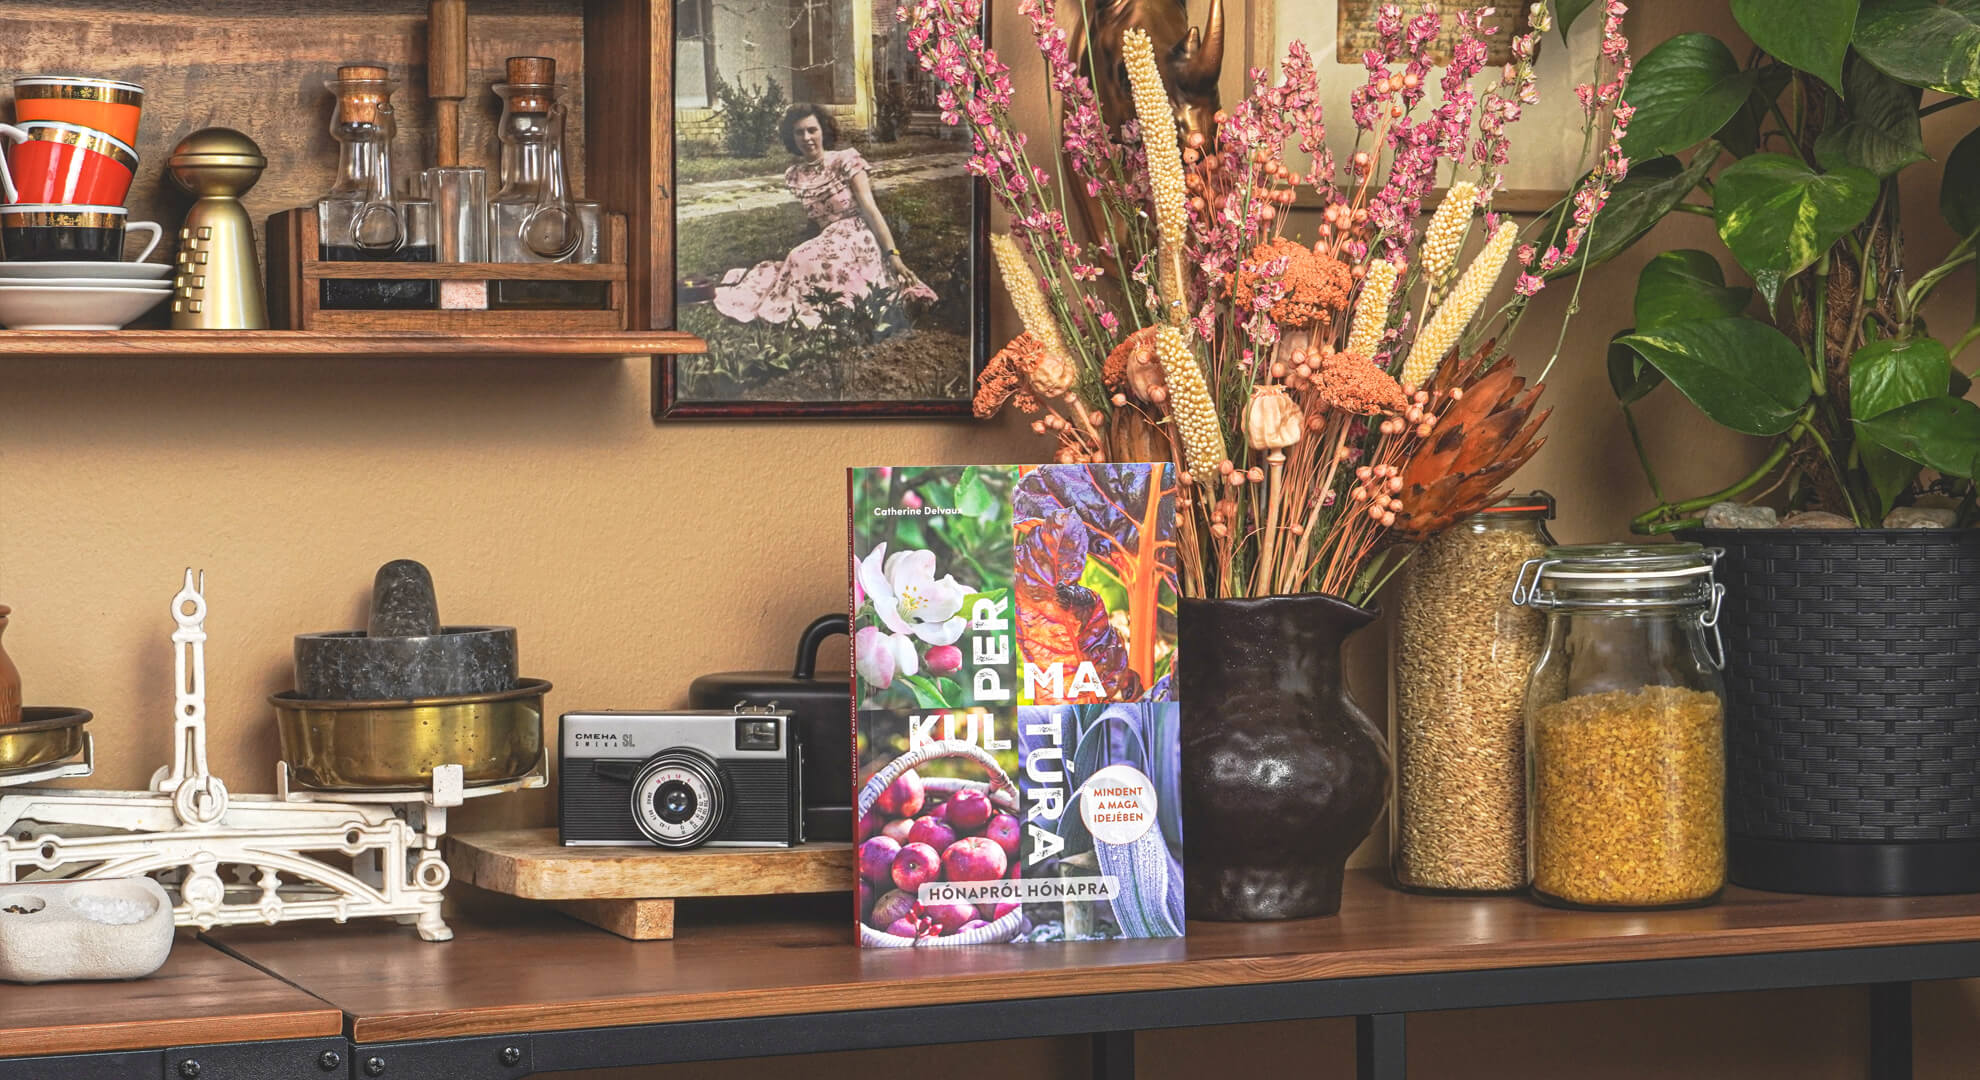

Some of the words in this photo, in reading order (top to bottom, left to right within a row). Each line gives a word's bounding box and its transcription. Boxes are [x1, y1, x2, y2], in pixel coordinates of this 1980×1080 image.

[873, 507, 921, 516] Catherine
[924, 506, 963, 515] Delvaux
[972, 597, 1010, 701] PER
[1023, 660, 1107, 700] MA
[622, 733, 636, 747] SL
[909, 713, 1012, 752] KUL
[1025, 713, 1075, 866] TÚRA
[1093, 786, 1144, 798] MINDENT
[1097, 801, 1106, 810] A
[1107, 800, 1139, 810] MAGA
[1093, 811, 1144, 823] IDEJÉBEN
[929, 883, 1022, 901] HÓNAPRÓL
[1027, 881, 1109, 898] HÓNAPRA
